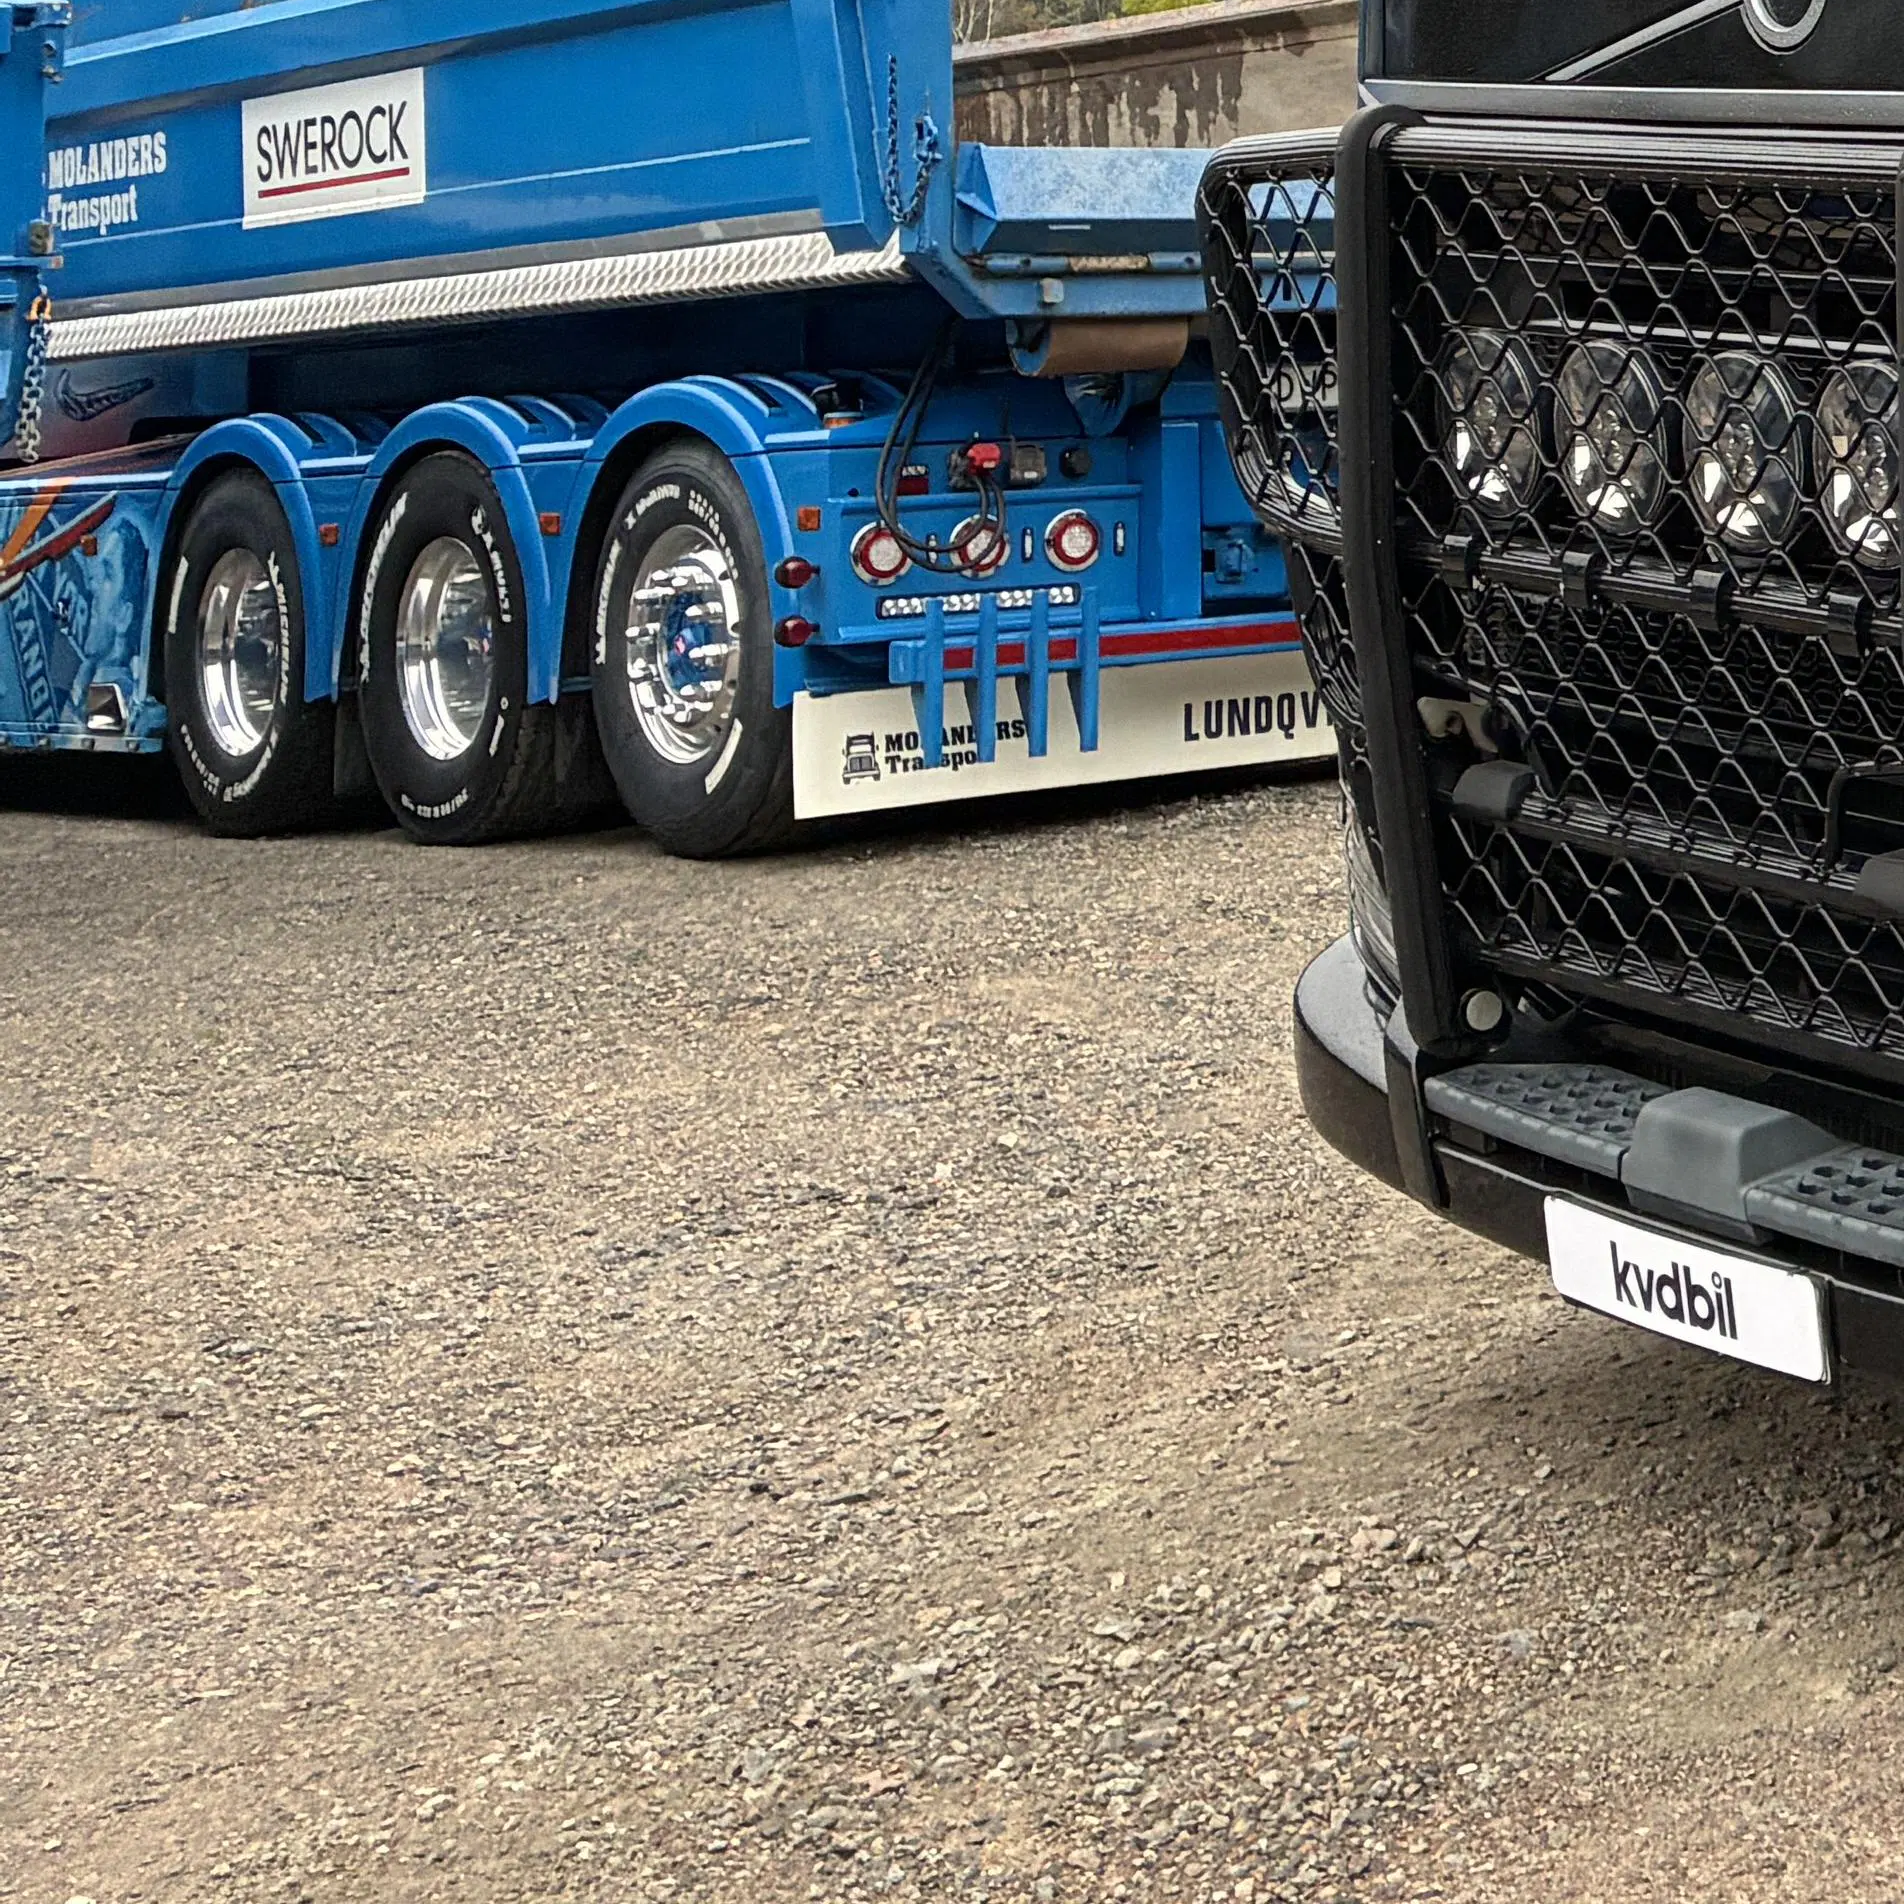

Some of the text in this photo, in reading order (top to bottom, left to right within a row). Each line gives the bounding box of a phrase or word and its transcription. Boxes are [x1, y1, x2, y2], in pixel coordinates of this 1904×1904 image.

[48, 131, 167, 190] MOLANDERS
[257, 100, 410, 183] SWEROCK
[47, 185, 138, 236] Transport
[1609, 1238, 1739, 1341] kvdbil
